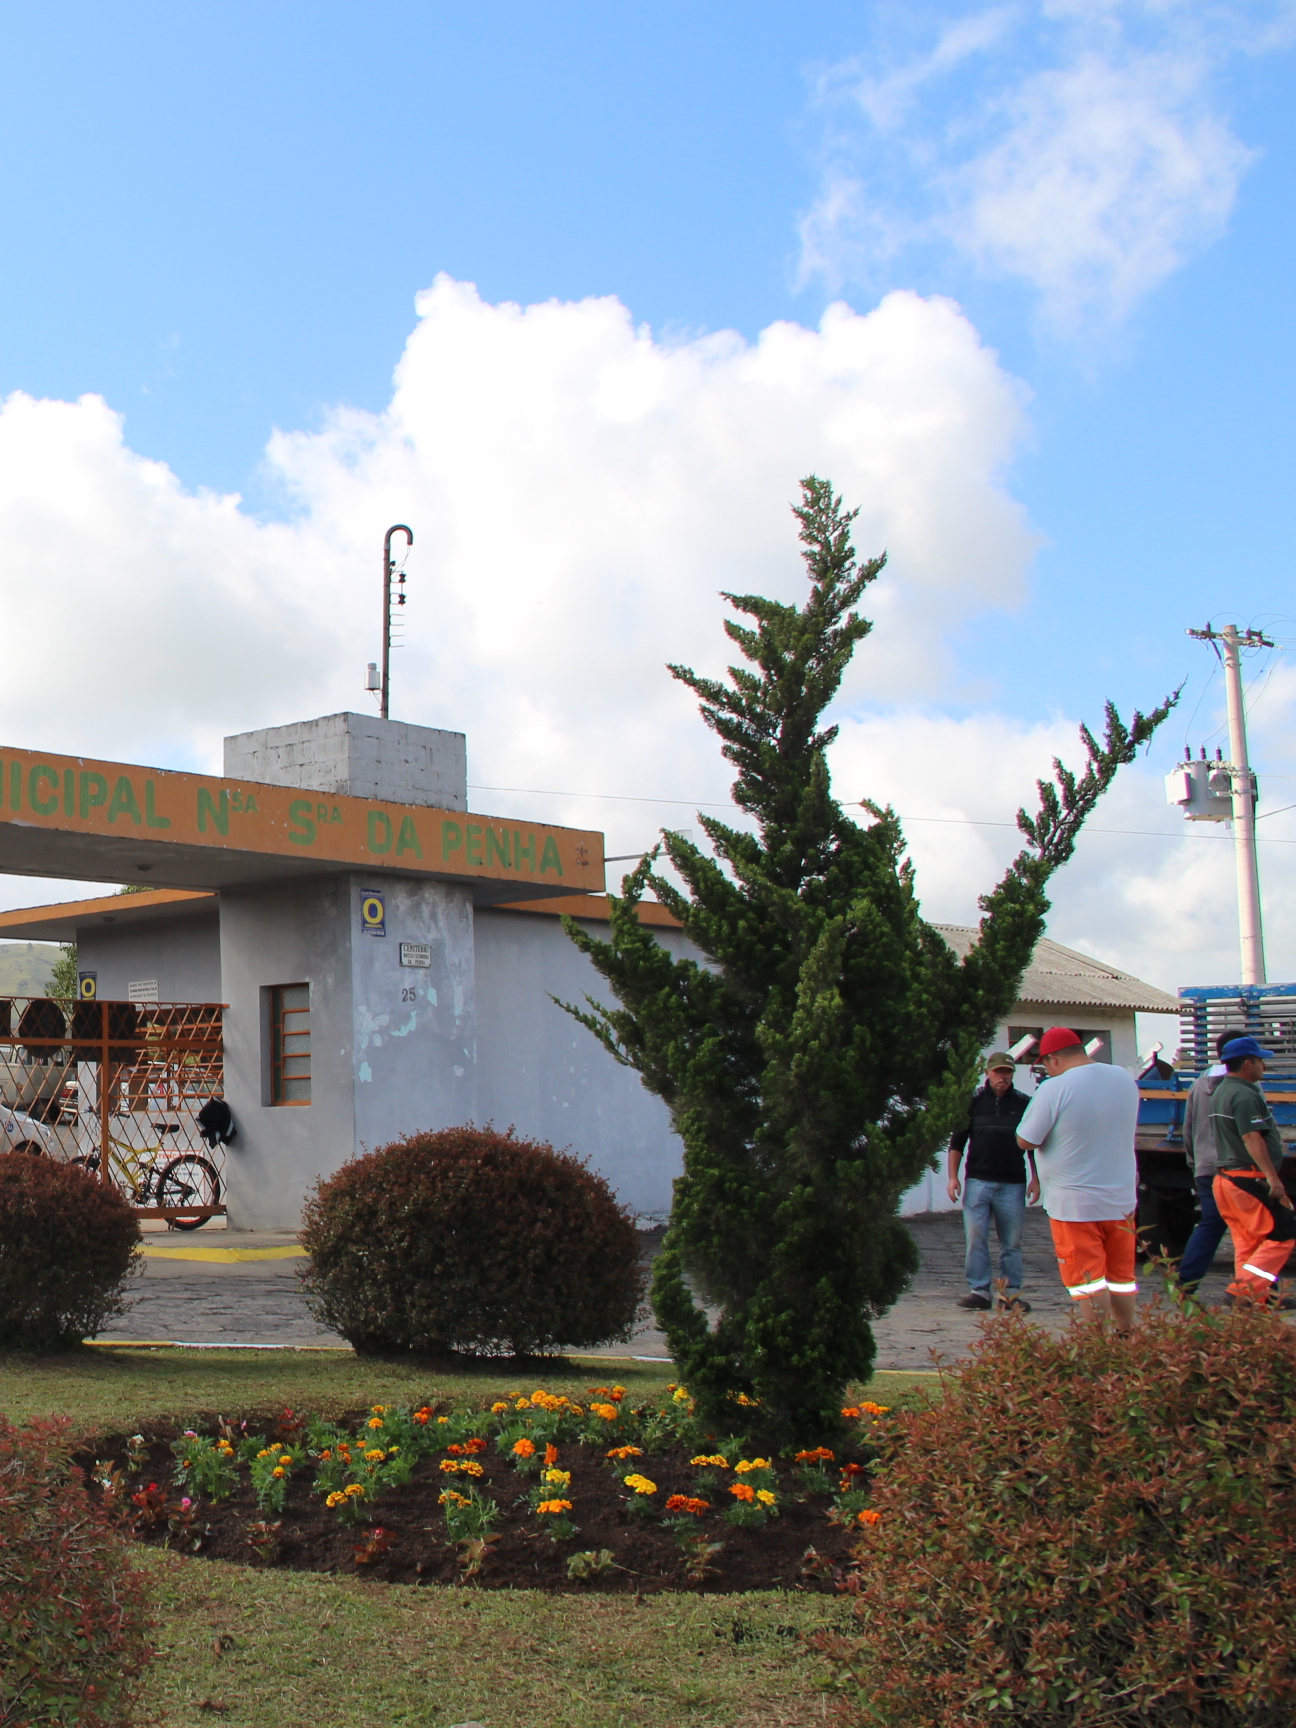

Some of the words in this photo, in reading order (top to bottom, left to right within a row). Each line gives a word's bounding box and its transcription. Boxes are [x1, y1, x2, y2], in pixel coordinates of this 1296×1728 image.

[367, 810, 423, 860] DA
[442, 821, 564, 876] PENHA
[401, 986, 417, 1002] 25
